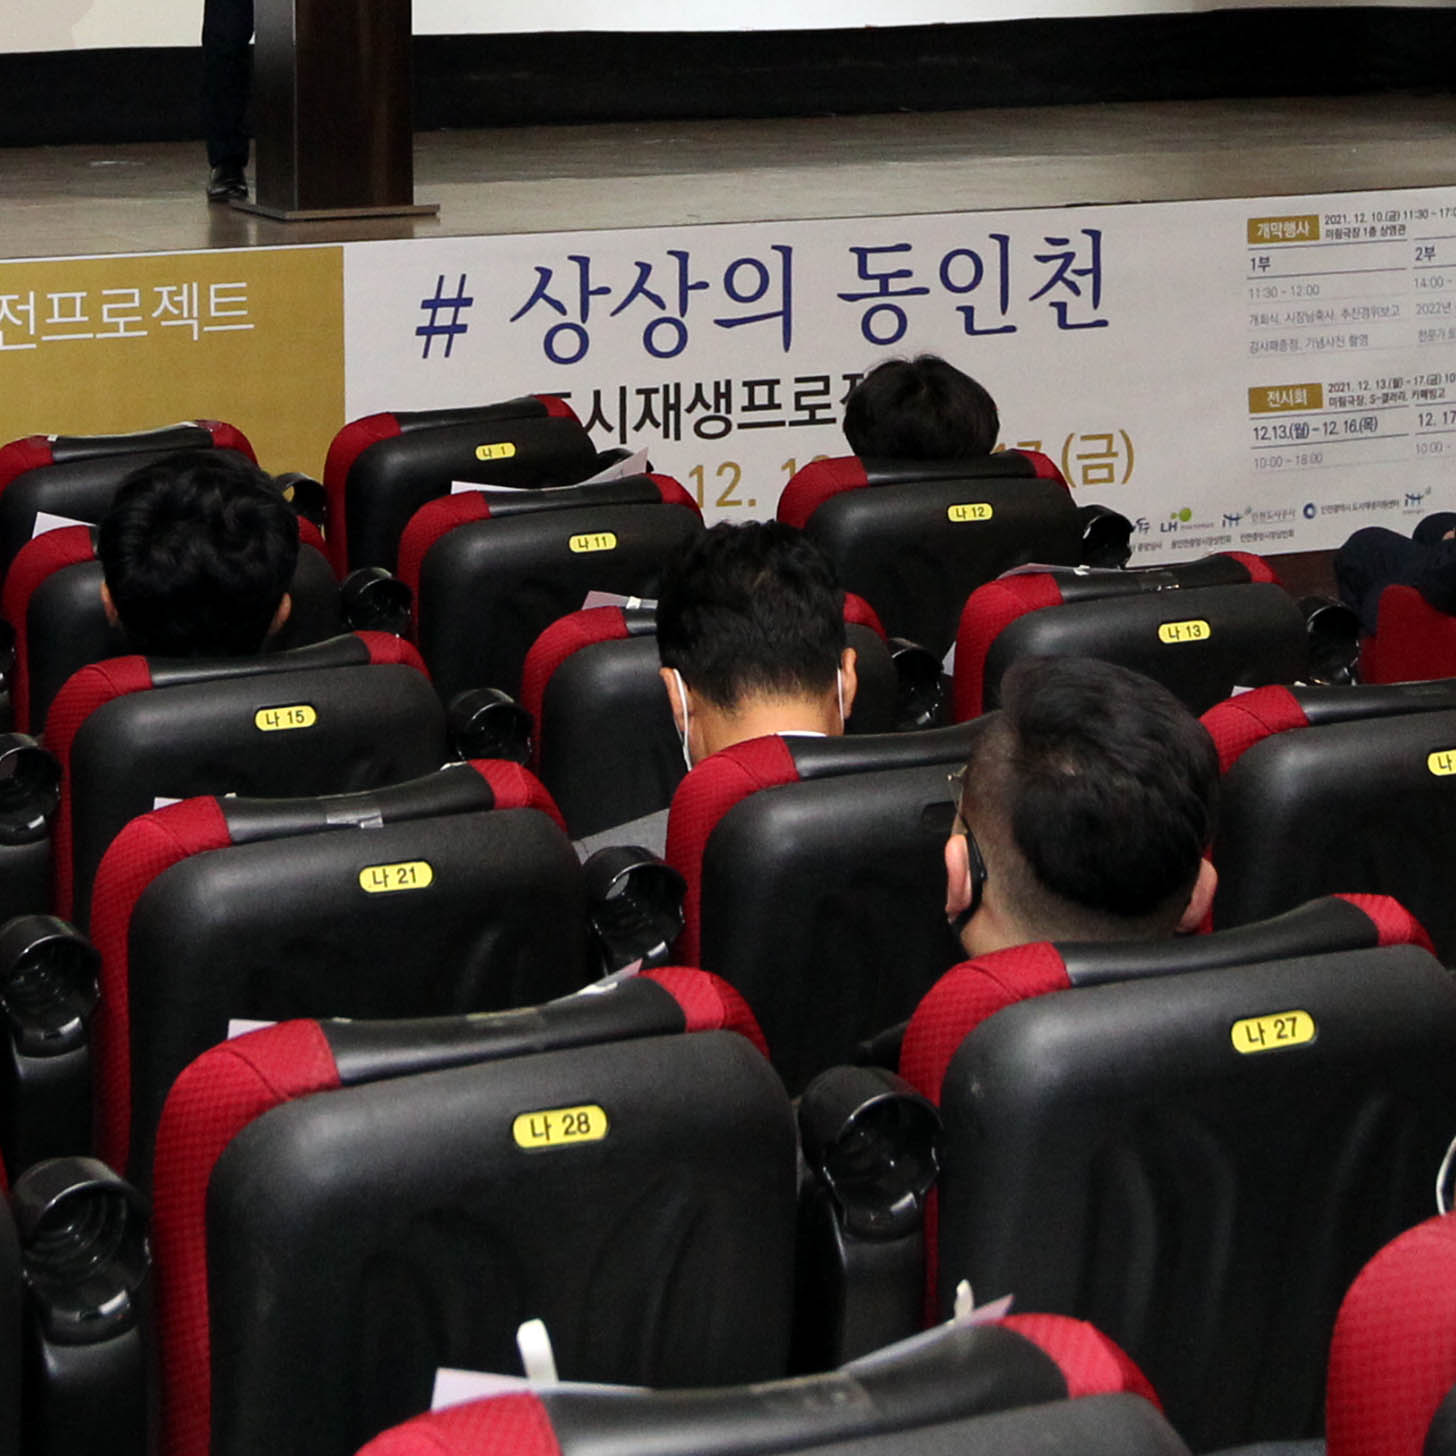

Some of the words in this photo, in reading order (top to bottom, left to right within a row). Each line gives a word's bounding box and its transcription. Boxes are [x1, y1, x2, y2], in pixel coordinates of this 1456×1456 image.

[1325, 214, 1350, 225] 2021.
[1403, 209, 1428, 221] 11:30
[1257, 221, 1310, 239] 개막행사
[1415, 246, 1436, 262] 2부
[1250, 256, 1270, 272] 1부
[1415, 275, 1444, 288] 14:00
[415, 273, 474, 359] #
[510, 244, 794, 365] 상상의
[836, 228, 1110, 346] 동인천
[1249, 286, 1278, 299] 11:30
[1291, 284, 1320, 297] 12:00
[1266, 388, 1308, 407] 전시회
[531, 373, 865, 444] 시재생프로
[1418, 412, 1437, 429] 12.
[1062, 428, 1134, 488] (금)
[956, 509, 966, 519] 나
[971, 507, 985, 517] 12
[1161, 522, 1177, 533] LH
[578, 538, 589, 549] 나
[594, 536, 608, 547] 11
[1168, 628, 1180, 640] 나
[1186, 625, 1201, 637] 13
[266, 713, 279, 727] 나
[287, 710, 305, 723] 15
[1438, 754, 1452, 771] 나
[373, 871, 389, 888] 나
[396, 868, 416, 884] 21
[1246, 1023, 1266, 1045] 나
[1276, 1018, 1298, 1039] 27
[530, 1117, 551, 1141] 나
[563, 1113, 591, 1135] 28
